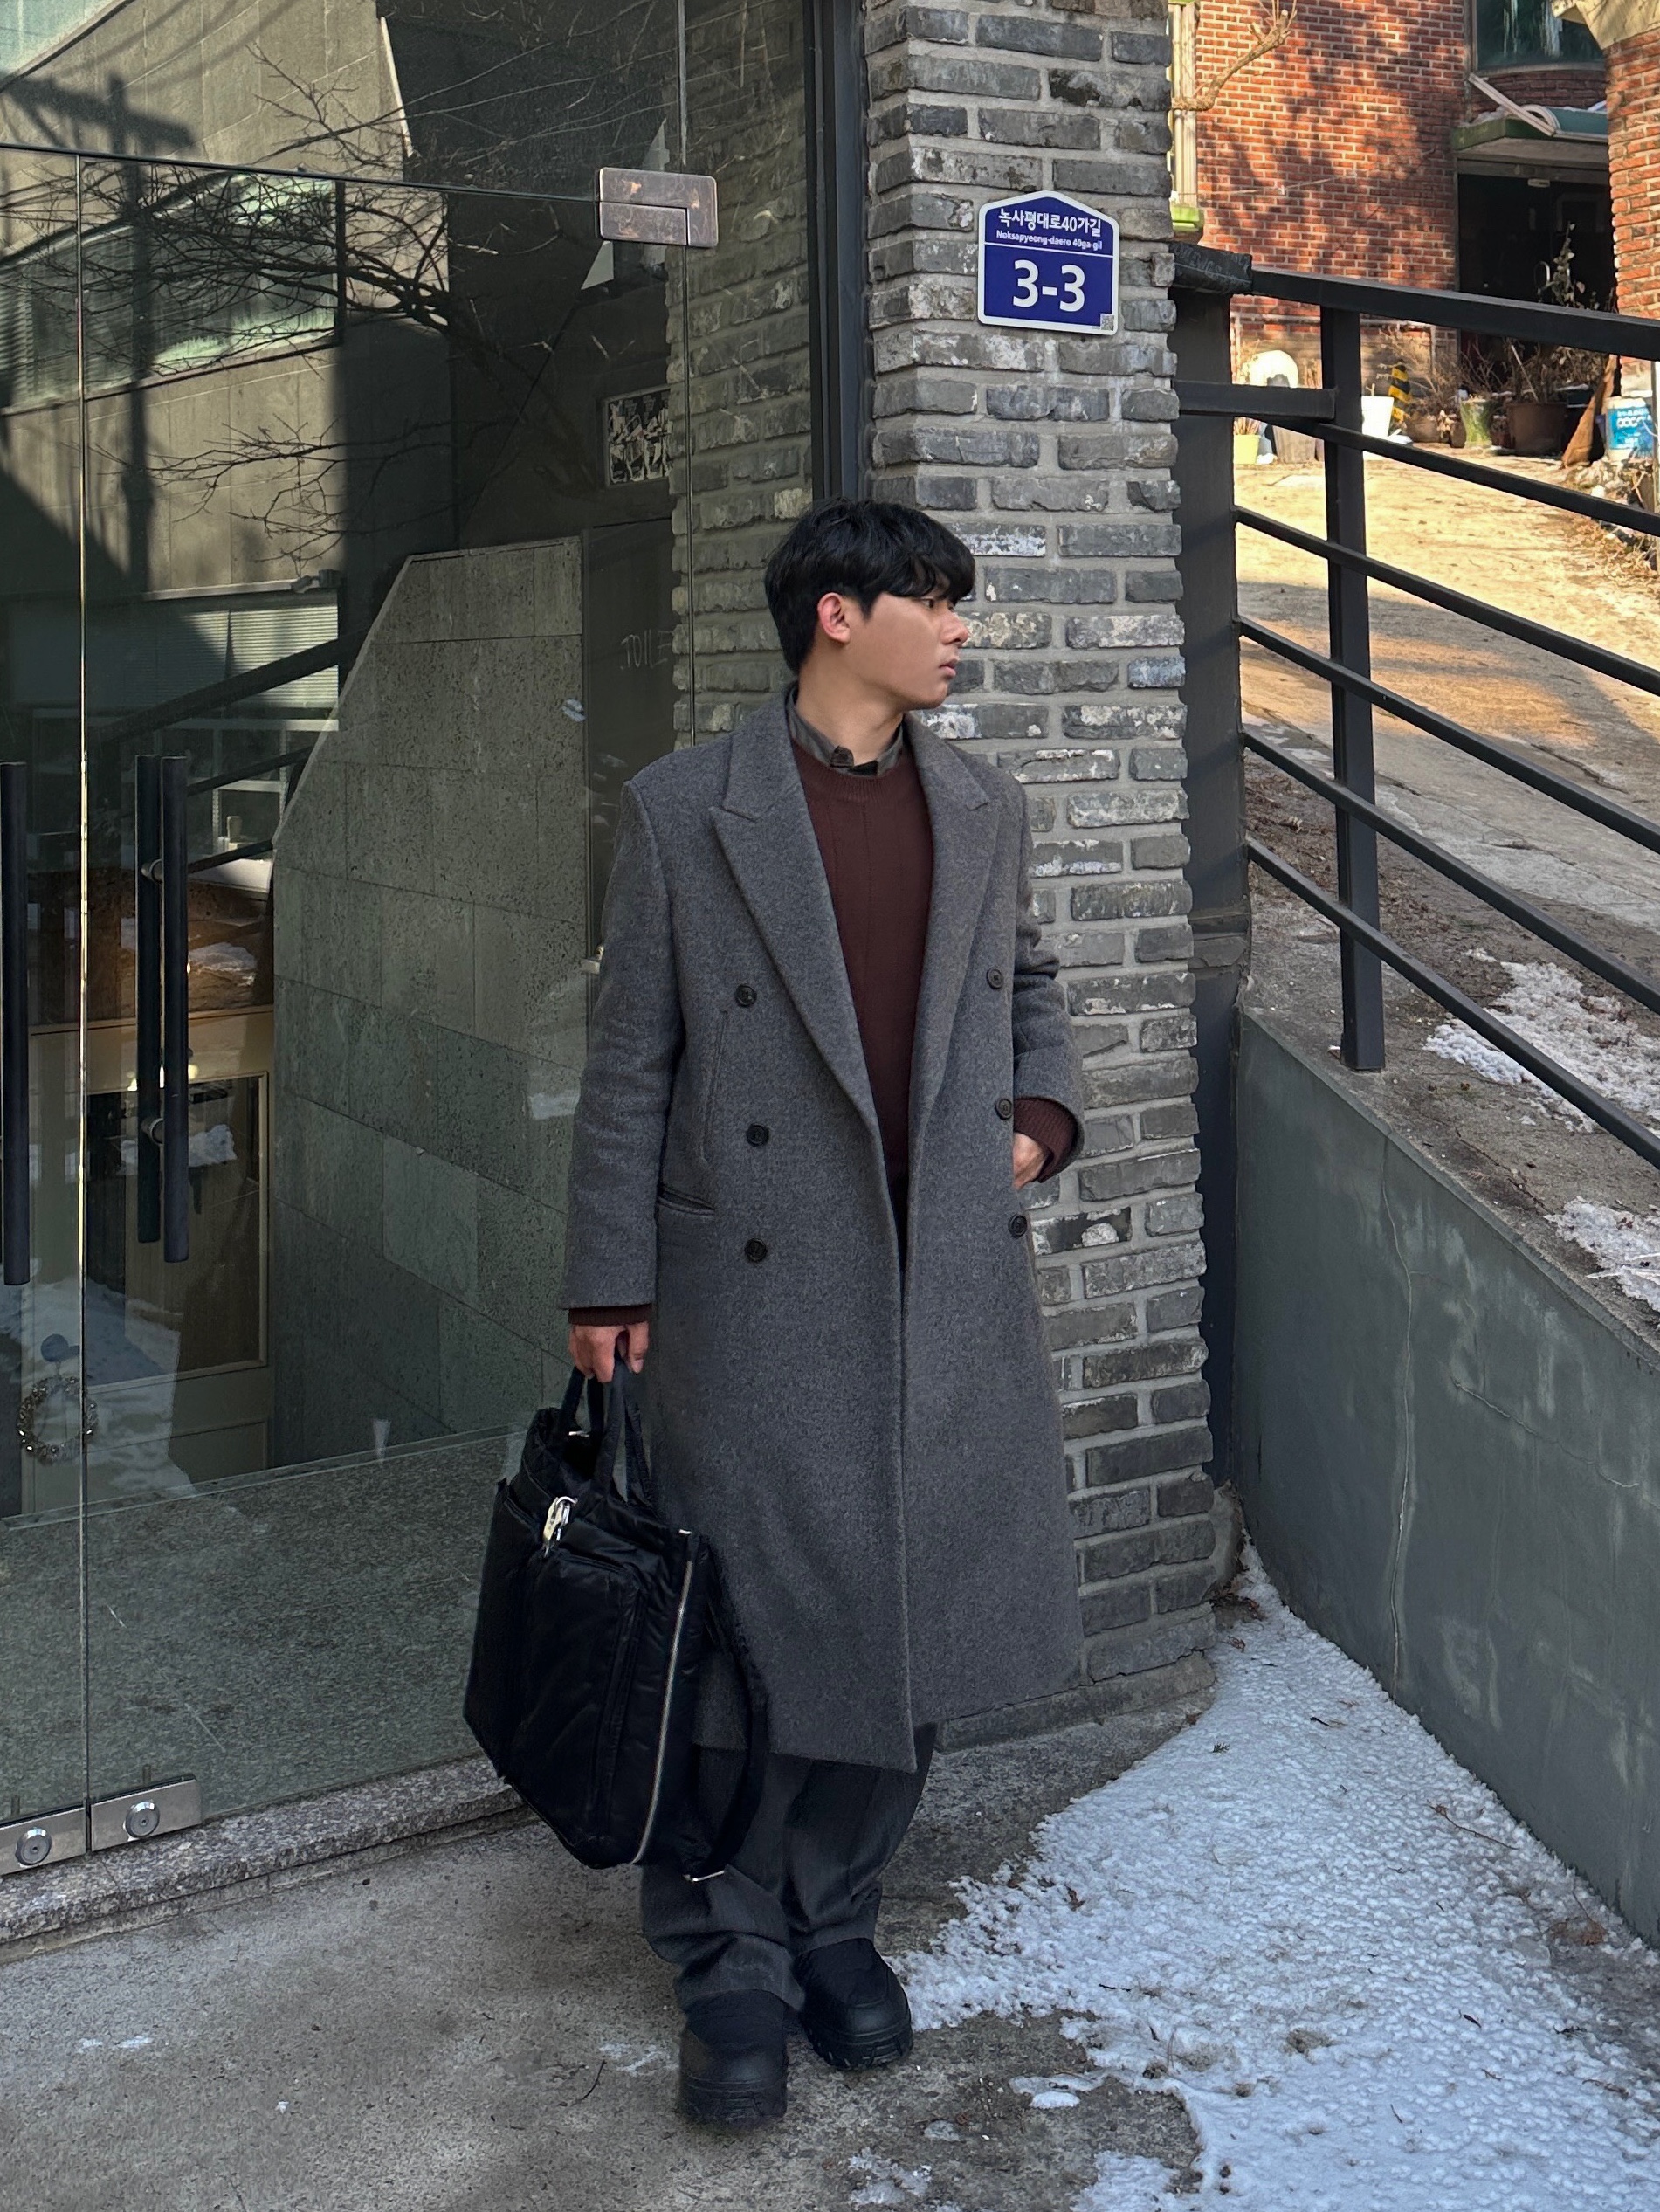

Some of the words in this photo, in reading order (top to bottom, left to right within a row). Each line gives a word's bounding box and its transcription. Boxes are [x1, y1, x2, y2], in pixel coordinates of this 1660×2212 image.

[998, 208, 1101, 237] 녹사평대로40가길
[996, 230, 1071, 245] Noksapyeong-daero
[1072, 238, 1102, 251] 40ga-gil
[1012, 259, 1085, 313] 3-3
